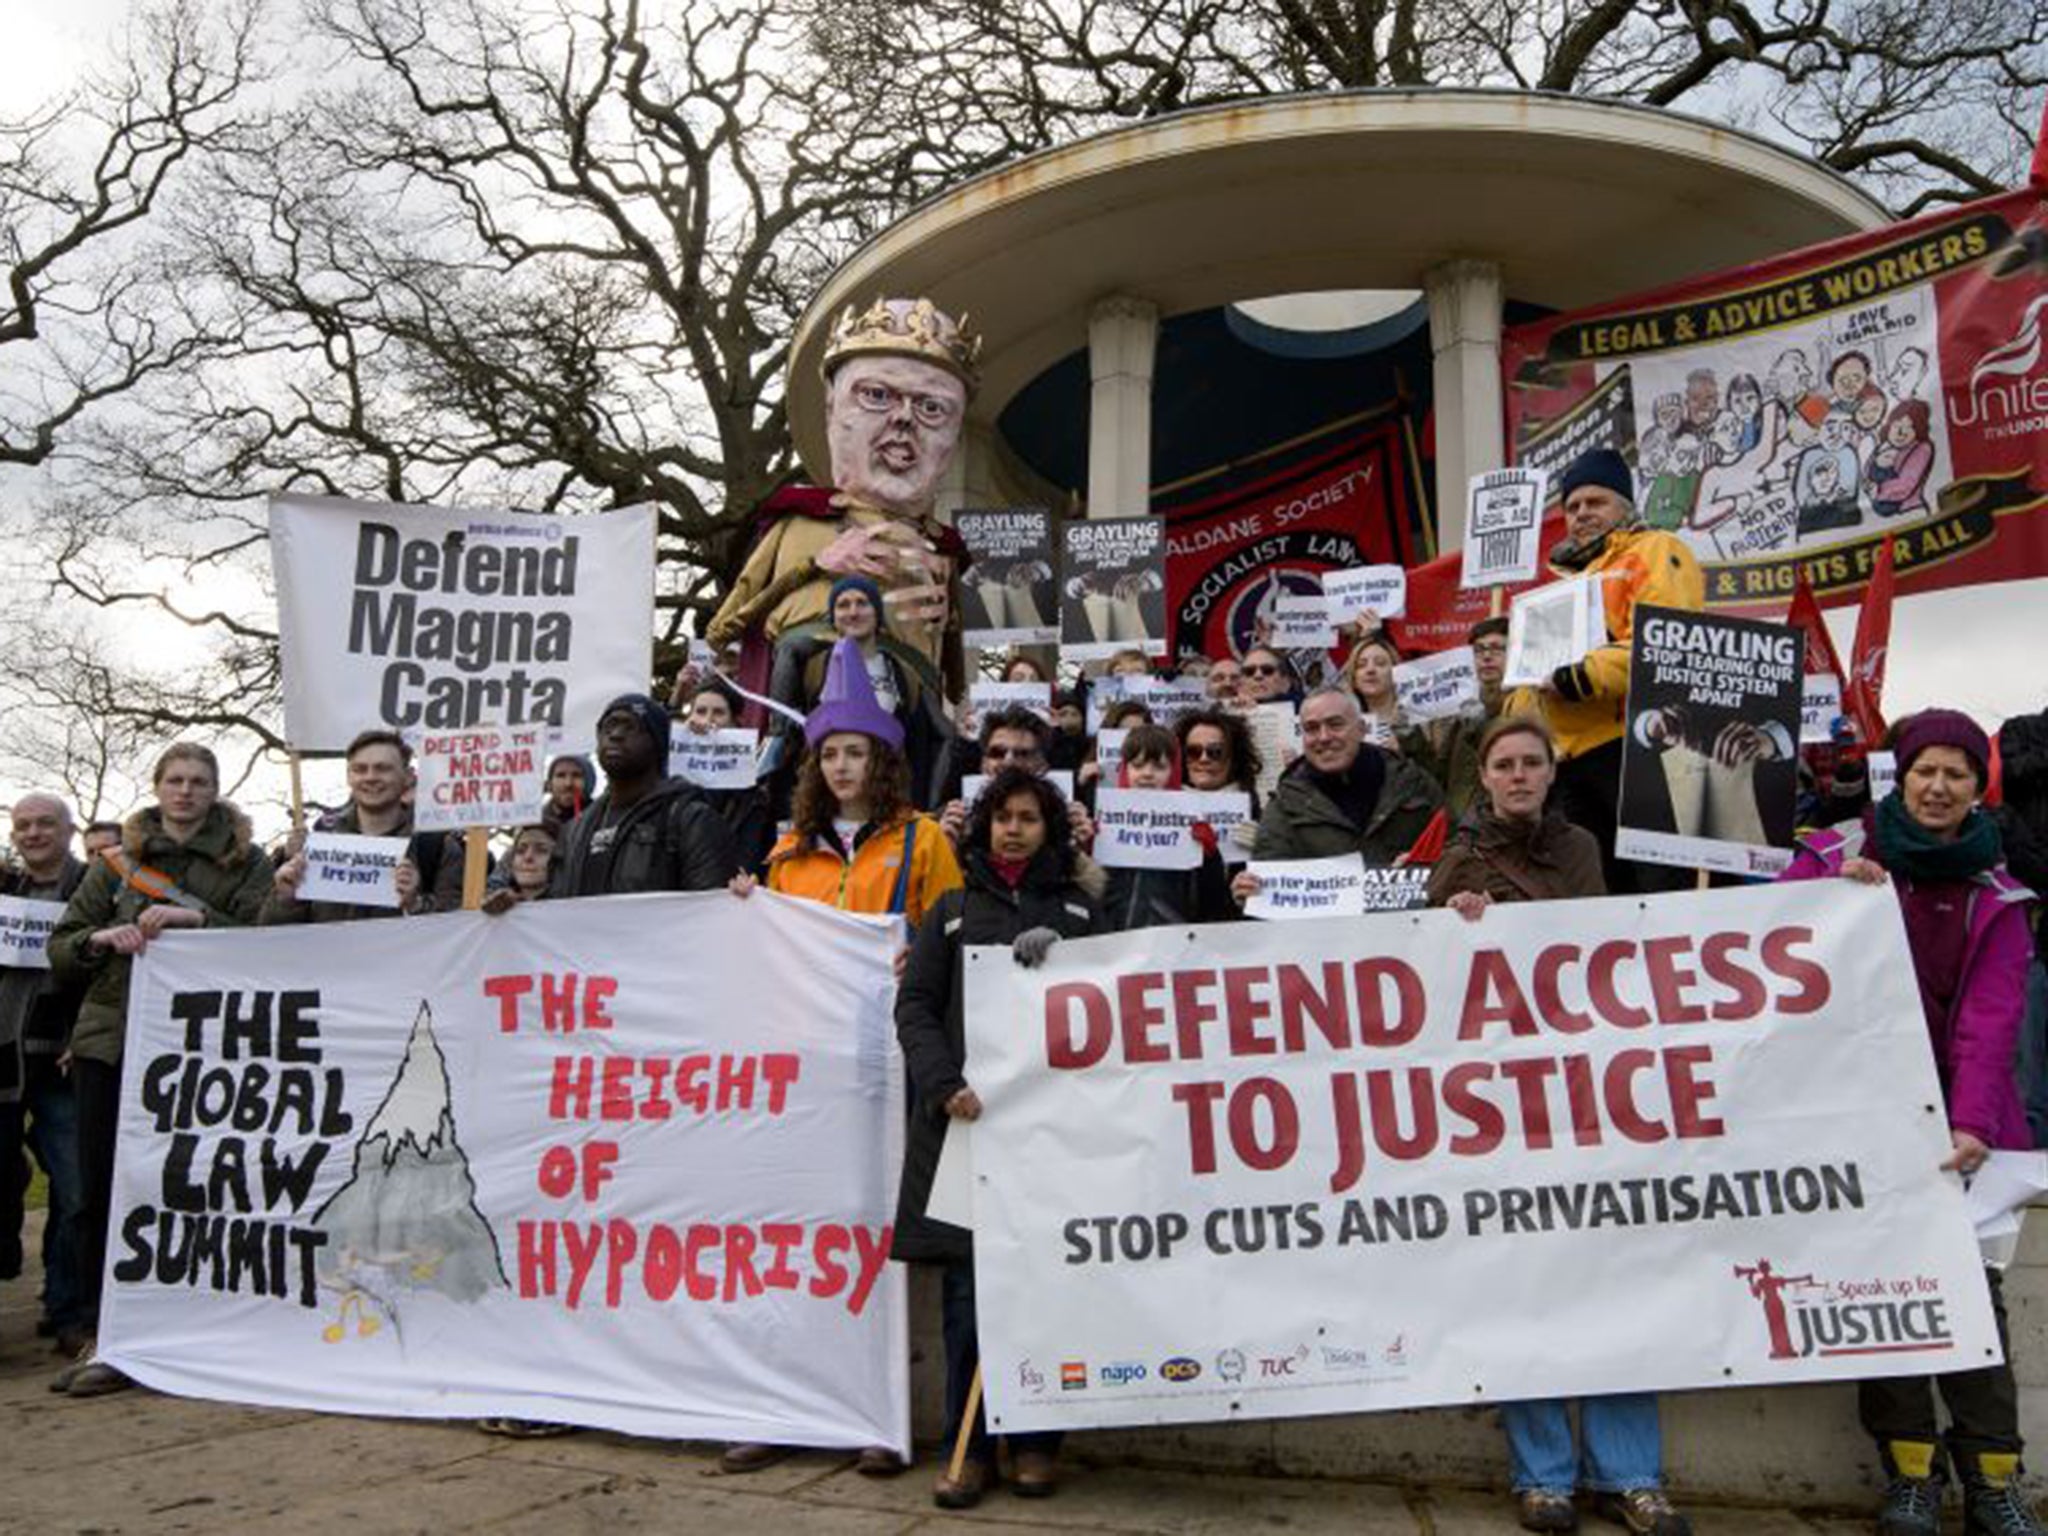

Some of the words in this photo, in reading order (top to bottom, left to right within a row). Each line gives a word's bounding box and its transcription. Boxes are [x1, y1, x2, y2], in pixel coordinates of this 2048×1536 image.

[1579, 315, 1664, 356] LEGAL
[1674, 308, 1698, 342] &
[1706, 285, 1815, 335] ADVICE
[1823, 226, 1988, 303] WORKERS
[1848, 304, 1889, 329] SAVE
[1836, 324, 1882, 345] LEGAL
[1543, 418, 1613, 474] astern
[957, 513, 1045, 532] GRAYLING
[1066, 521, 1159, 543] GRAYLING
[1164, 515, 1263, 556] ALDANE
[1272, 465, 1374, 527] SOCIETY
[354, 521, 579, 597] Defend
[1181, 536, 1291, 624] SOCIALIST
[1716, 572, 1736, 595] &
[1922, 518, 1972, 555] ALL
[347, 590, 572, 672] Magna
[1643, 618, 1795, 665] GRAYLING
[1642, 647, 1683, 665] STOP
[1686, 652, 1755, 676] TEARING
[1758, 663, 1794, 682] OUR
[1653, 665, 1713, 688] JUSTICE
[1716, 674, 1779, 698] SYSTEM
[379, 661, 567, 730] Carta
[1688, 686, 1744, 709] APART
[424, 734, 501, 755] DEFEND
[512, 732, 536, 745] THE
[448, 749, 533, 777] MAGNA
[433, 779, 514, 804] CARTA
[1103, 811, 1124, 824] am
[1126, 809, 1148, 825] for
[1117, 828, 1144, 845] Are
[1145, 830, 1180, 849] you?
[322, 865, 346, 882] Are
[349, 869, 380, 885] you?
[1270, 892, 1299, 907] Are
[1302, 893, 1339, 908] you?
[1280, 876, 1304, 890] for
[484, 972, 619, 1034] THE
[1044, 956, 1427, 1070] DEFEND
[1457, 925, 1832, 1042] ACCESS
[170, 989, 323, 1065] THE
[141, 1052, 354, 1138] GLOBAL
[548, 1053, 801, 1122] HEIGHT
[1171, 1076, 1300, 1175] TO
[1330, 1044, 1725, 1194] JUSTICE
[162, 1133, 331, 1215] LAW
[537, 1140, 620, 1203] OF
[1063, 1211, 1189, 1265] STOP
[1203, 1201, 1325, 1255] CUTS
[1337, 1193, 1450, 1247] AND
[1463, 1162, 1866, 1237] PRIVATISATION
[113, 1204, 328, 1308] SUMMIT
[516, 1217, 894, 1317] HYPOCRISY
[1889, 1280, 1915, 1298] up
[1916, 1274, 1939, 1293] for
[1101, 1363, 1147, 1384] napo
[1259, 1356, 1296, 1377] TUC
